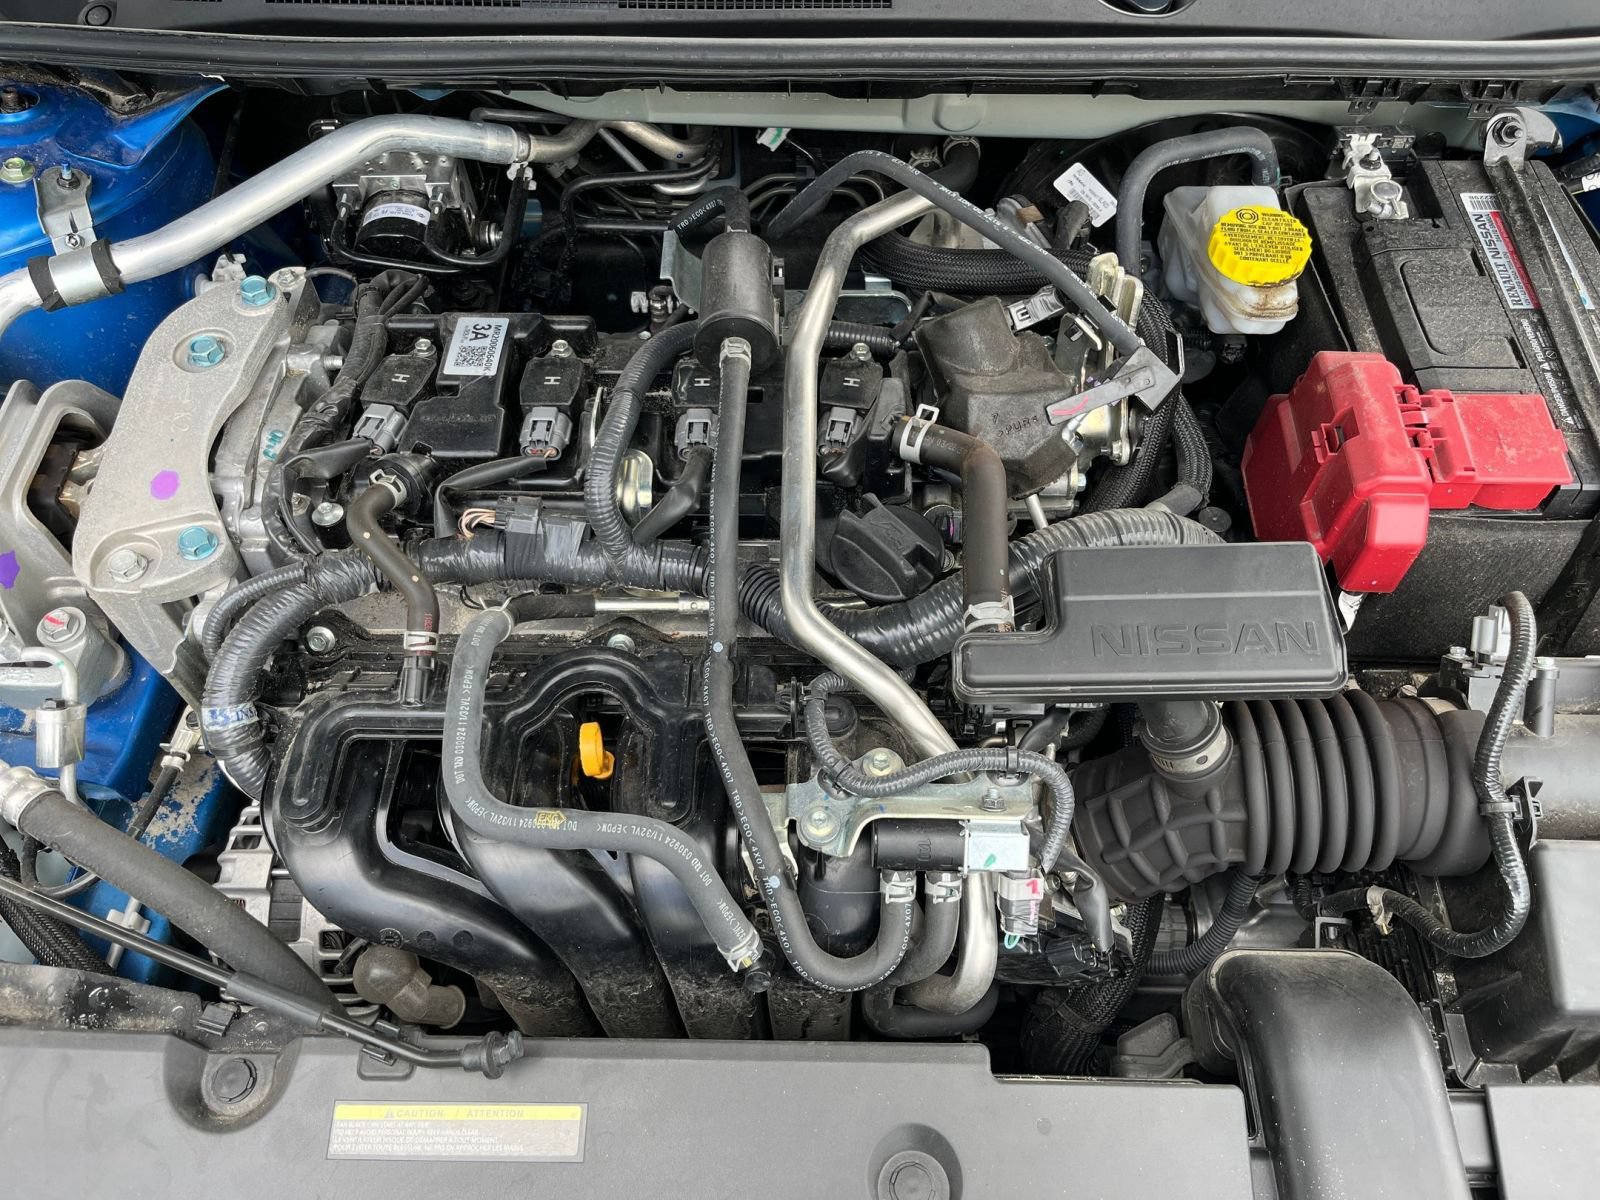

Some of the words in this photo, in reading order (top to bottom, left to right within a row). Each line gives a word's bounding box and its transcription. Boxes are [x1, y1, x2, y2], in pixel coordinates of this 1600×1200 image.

[1473, 213, 1502, 260] NISSAN
[1494, 262, 1524, 306] RENAULT
[469, 323, 492, 341] 3A
[391, 373, 410, 383] H
[544, 376, 561, 385] H
[693, 378, 711, 387] H
[842, 377, 861, 387] H
[1090, 620, 1321, 657] NISSAN
[455, 727, 467, 754] 030924
[664, 836, 693, 860] 030924
[396, 1109, 444, 1118] CAUTION
[466, 1109, 525, 1118] ATTENTION
